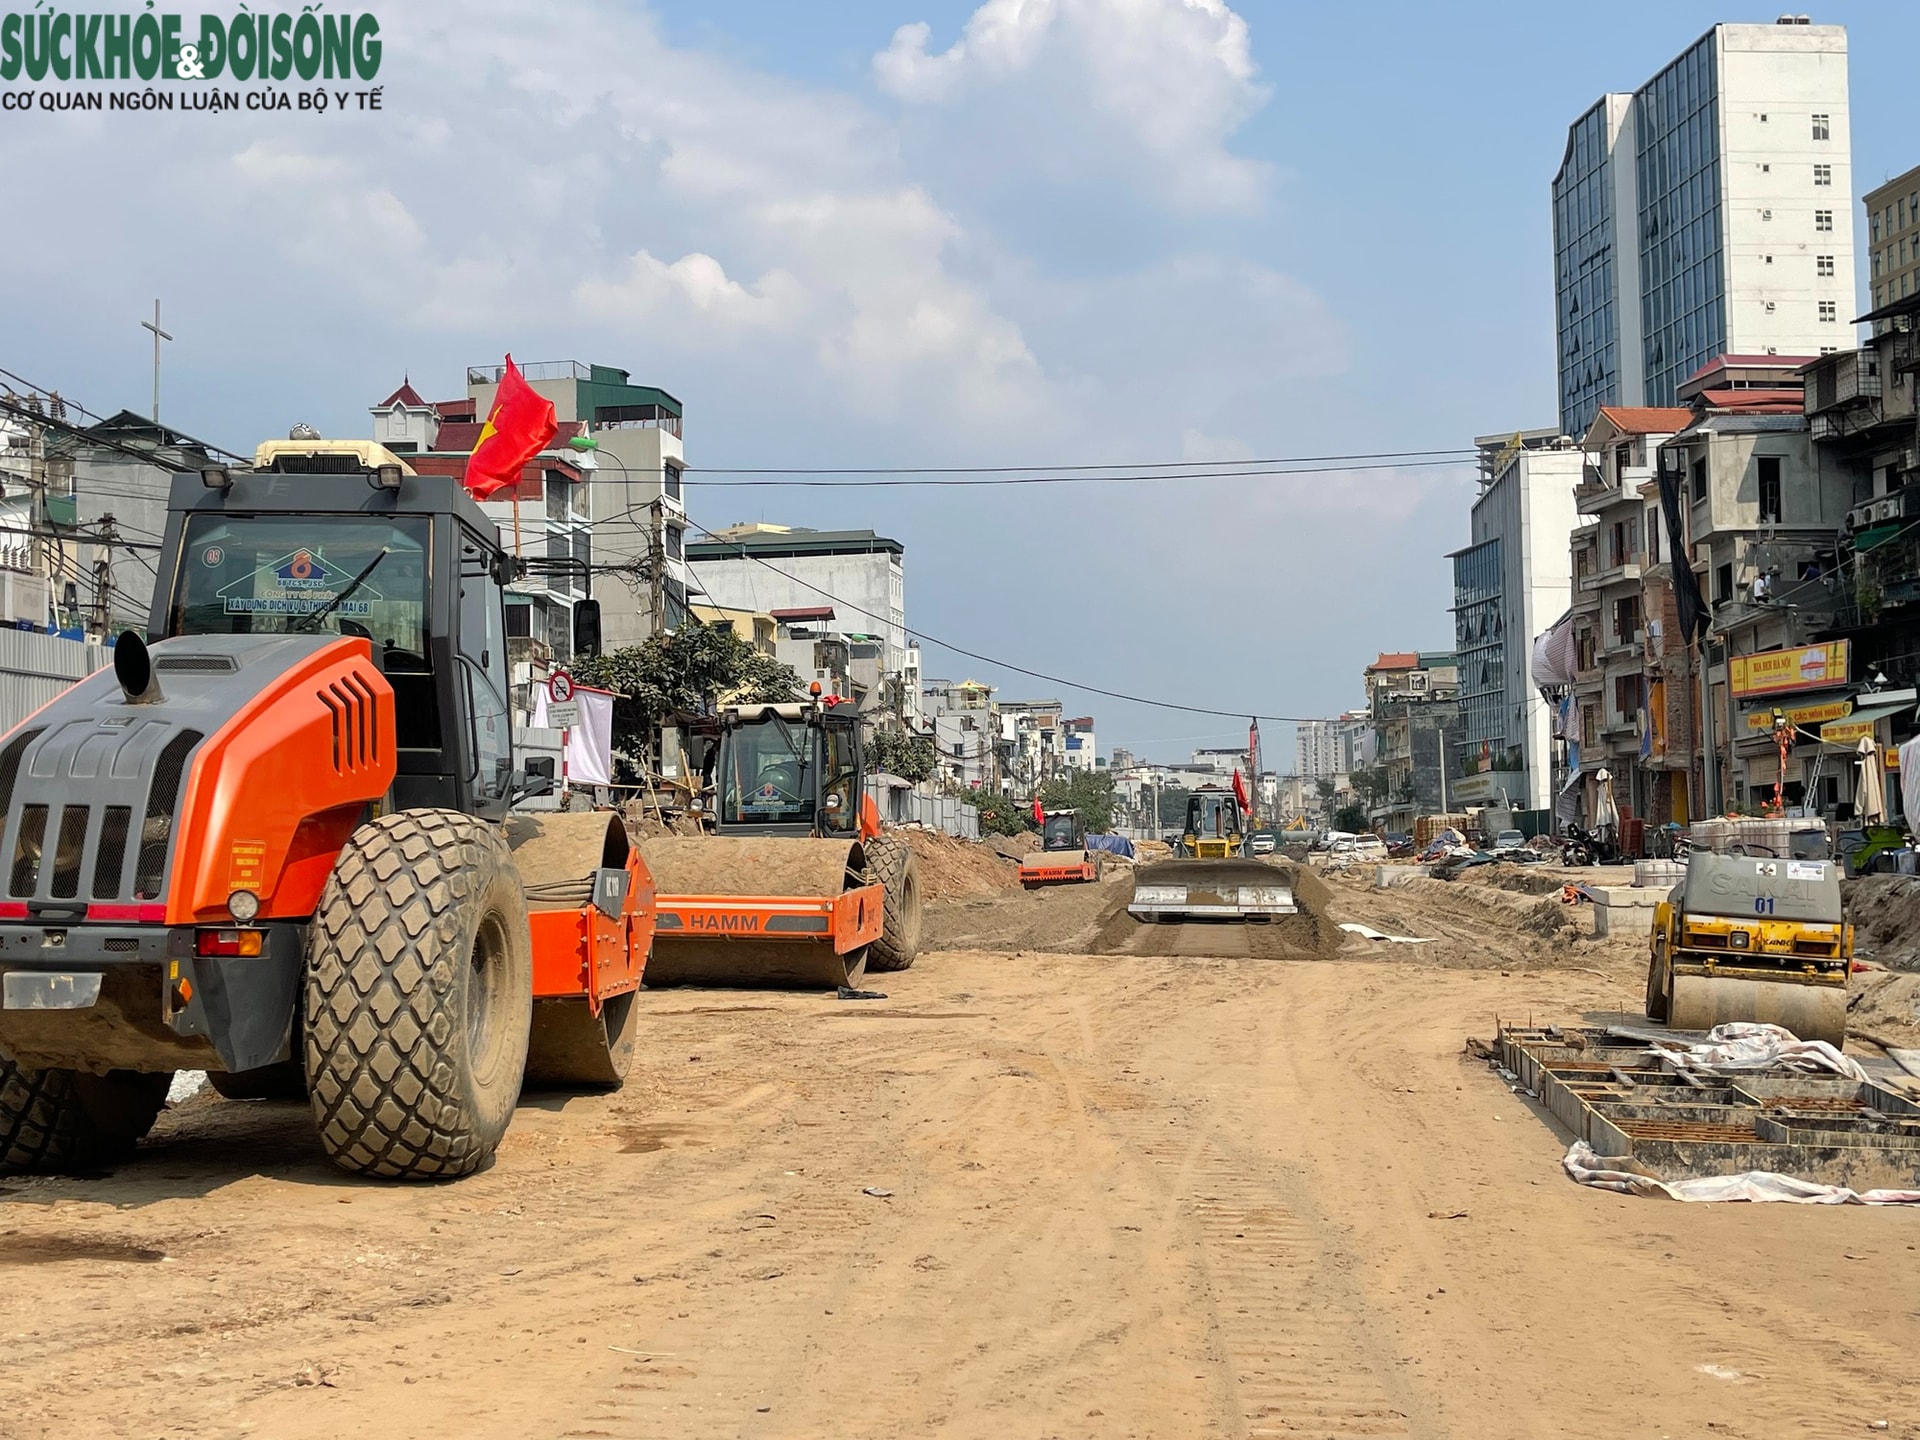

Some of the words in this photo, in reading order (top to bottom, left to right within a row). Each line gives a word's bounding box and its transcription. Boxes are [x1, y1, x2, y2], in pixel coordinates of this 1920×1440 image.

[358, 603, 369, 613] 68
[1754, 897, 1774, 914] 01
[690, 914, 759, 931] HAMM
